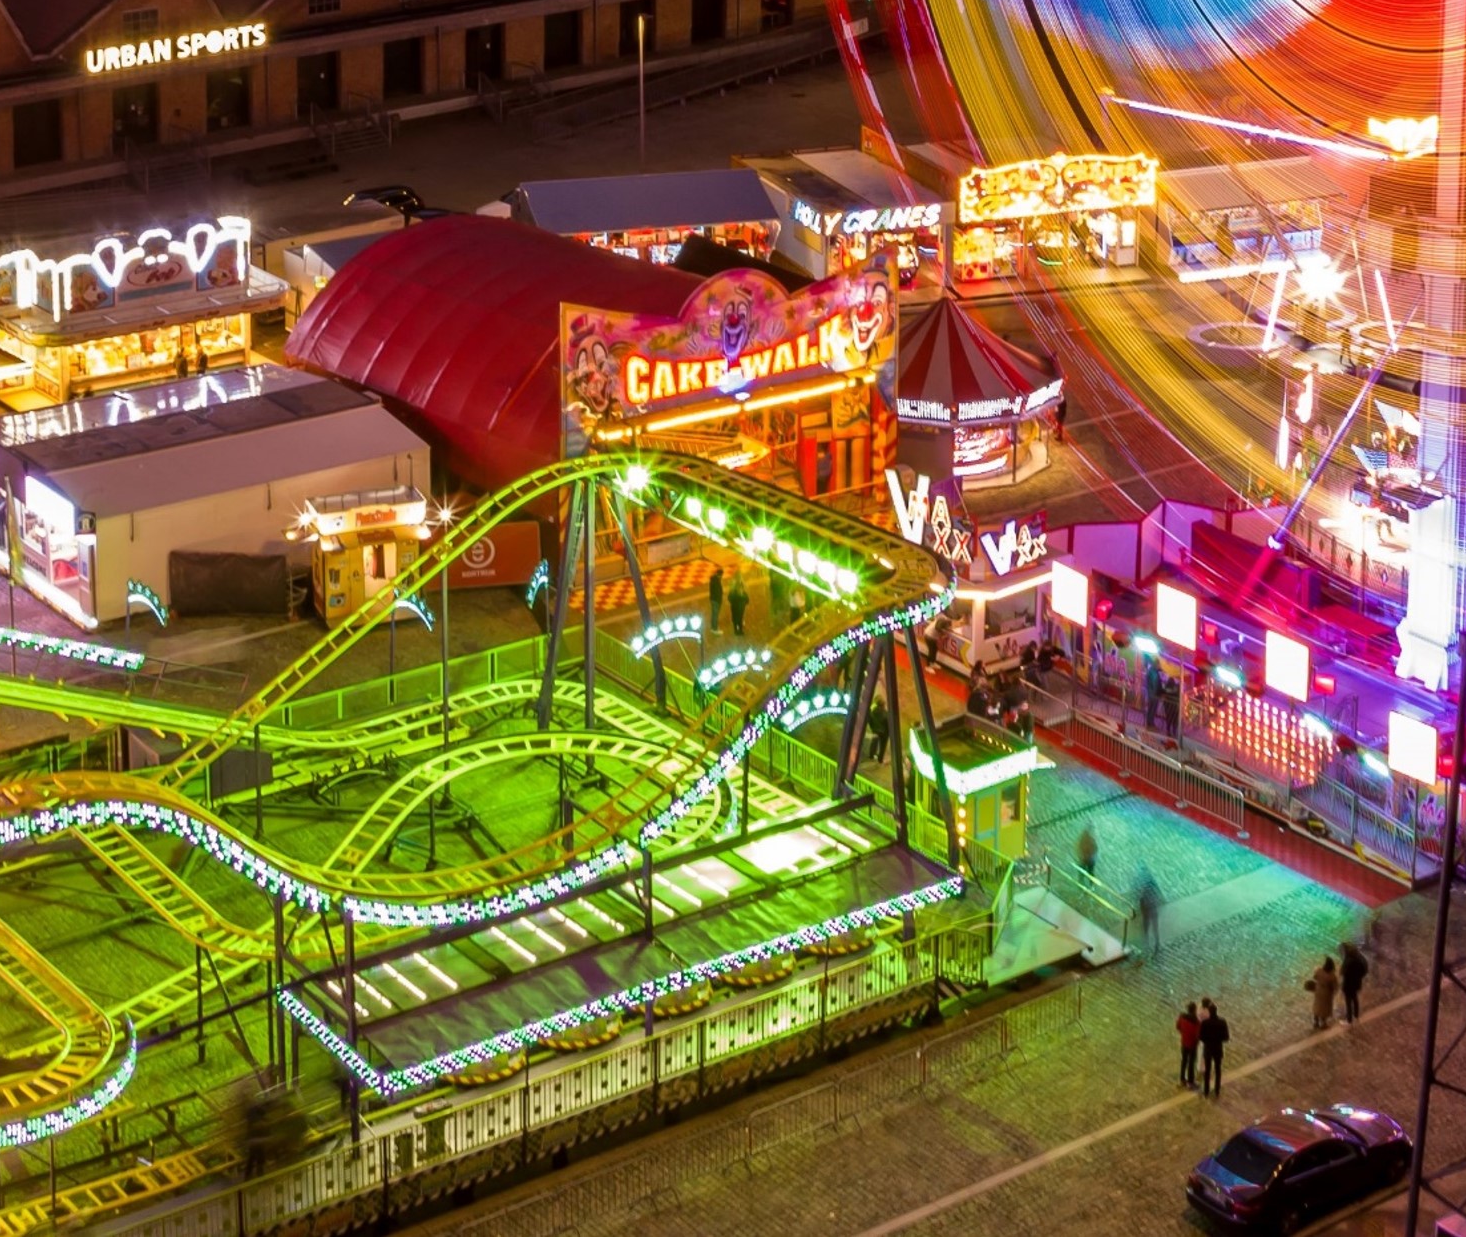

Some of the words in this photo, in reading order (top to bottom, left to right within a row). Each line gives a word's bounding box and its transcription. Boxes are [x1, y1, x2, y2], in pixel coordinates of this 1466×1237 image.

[86, 38, 172, 74] URBAN
[177, 22, 267, 59] SPORTS
[795, 200, 842, 236] HOLLY
[843, 203, 942, 234] CRANES
